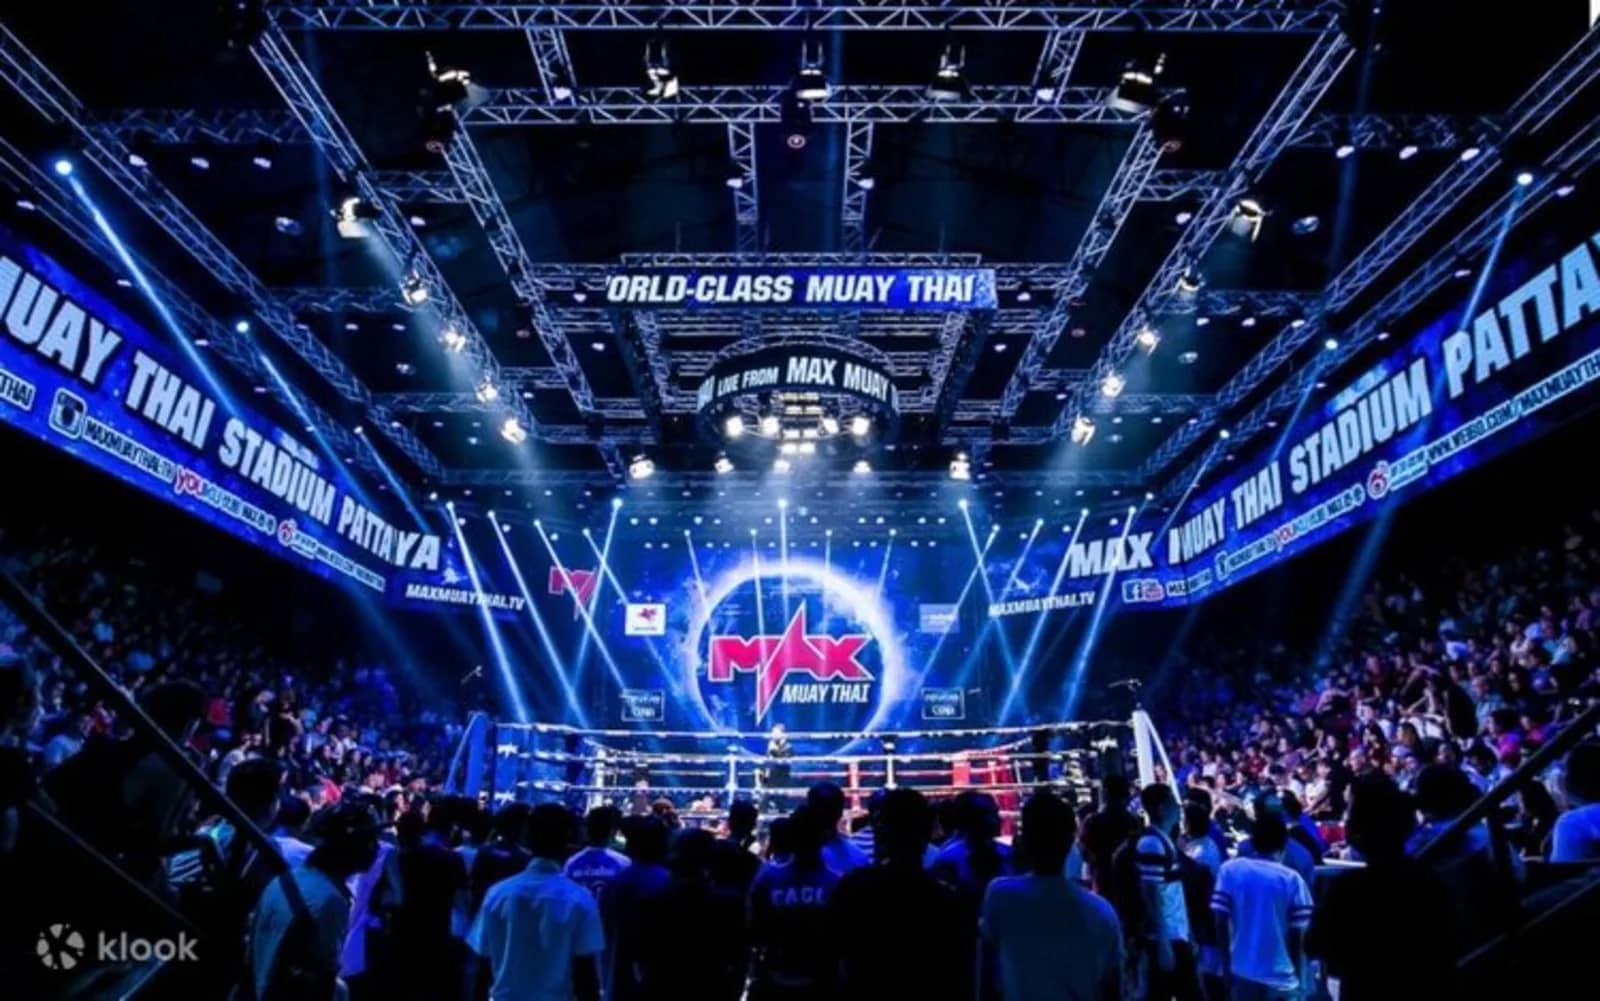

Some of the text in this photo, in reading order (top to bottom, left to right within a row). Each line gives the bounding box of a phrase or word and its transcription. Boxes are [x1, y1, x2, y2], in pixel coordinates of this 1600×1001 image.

[605, 275, 975, 302] ORLD-CLASS MUAY THAI
[717, 374, 741, 398] LIVE
[742, 366, 779, 389] FROM
[786, 356, 838, 386] MAX
[843, 362, 890, 402] MUAY
[1070, 532, 1153, 578] MAX
[1169, 498, 1225, 565] MUAY
[1231, 461, 1283, 530] THAI
[1290, 357, 1433, 494] STADIUM
[1443, 232, 1600, 399] PATTA
[125, 350, 215, 450] THAI
[219, 417, 336, 525] STADIUM
[337, 495, 440, 571] PATTAYA
[708, 600, 876, 725] MAX
[781, 683, 871, 703] MUAY THAI
